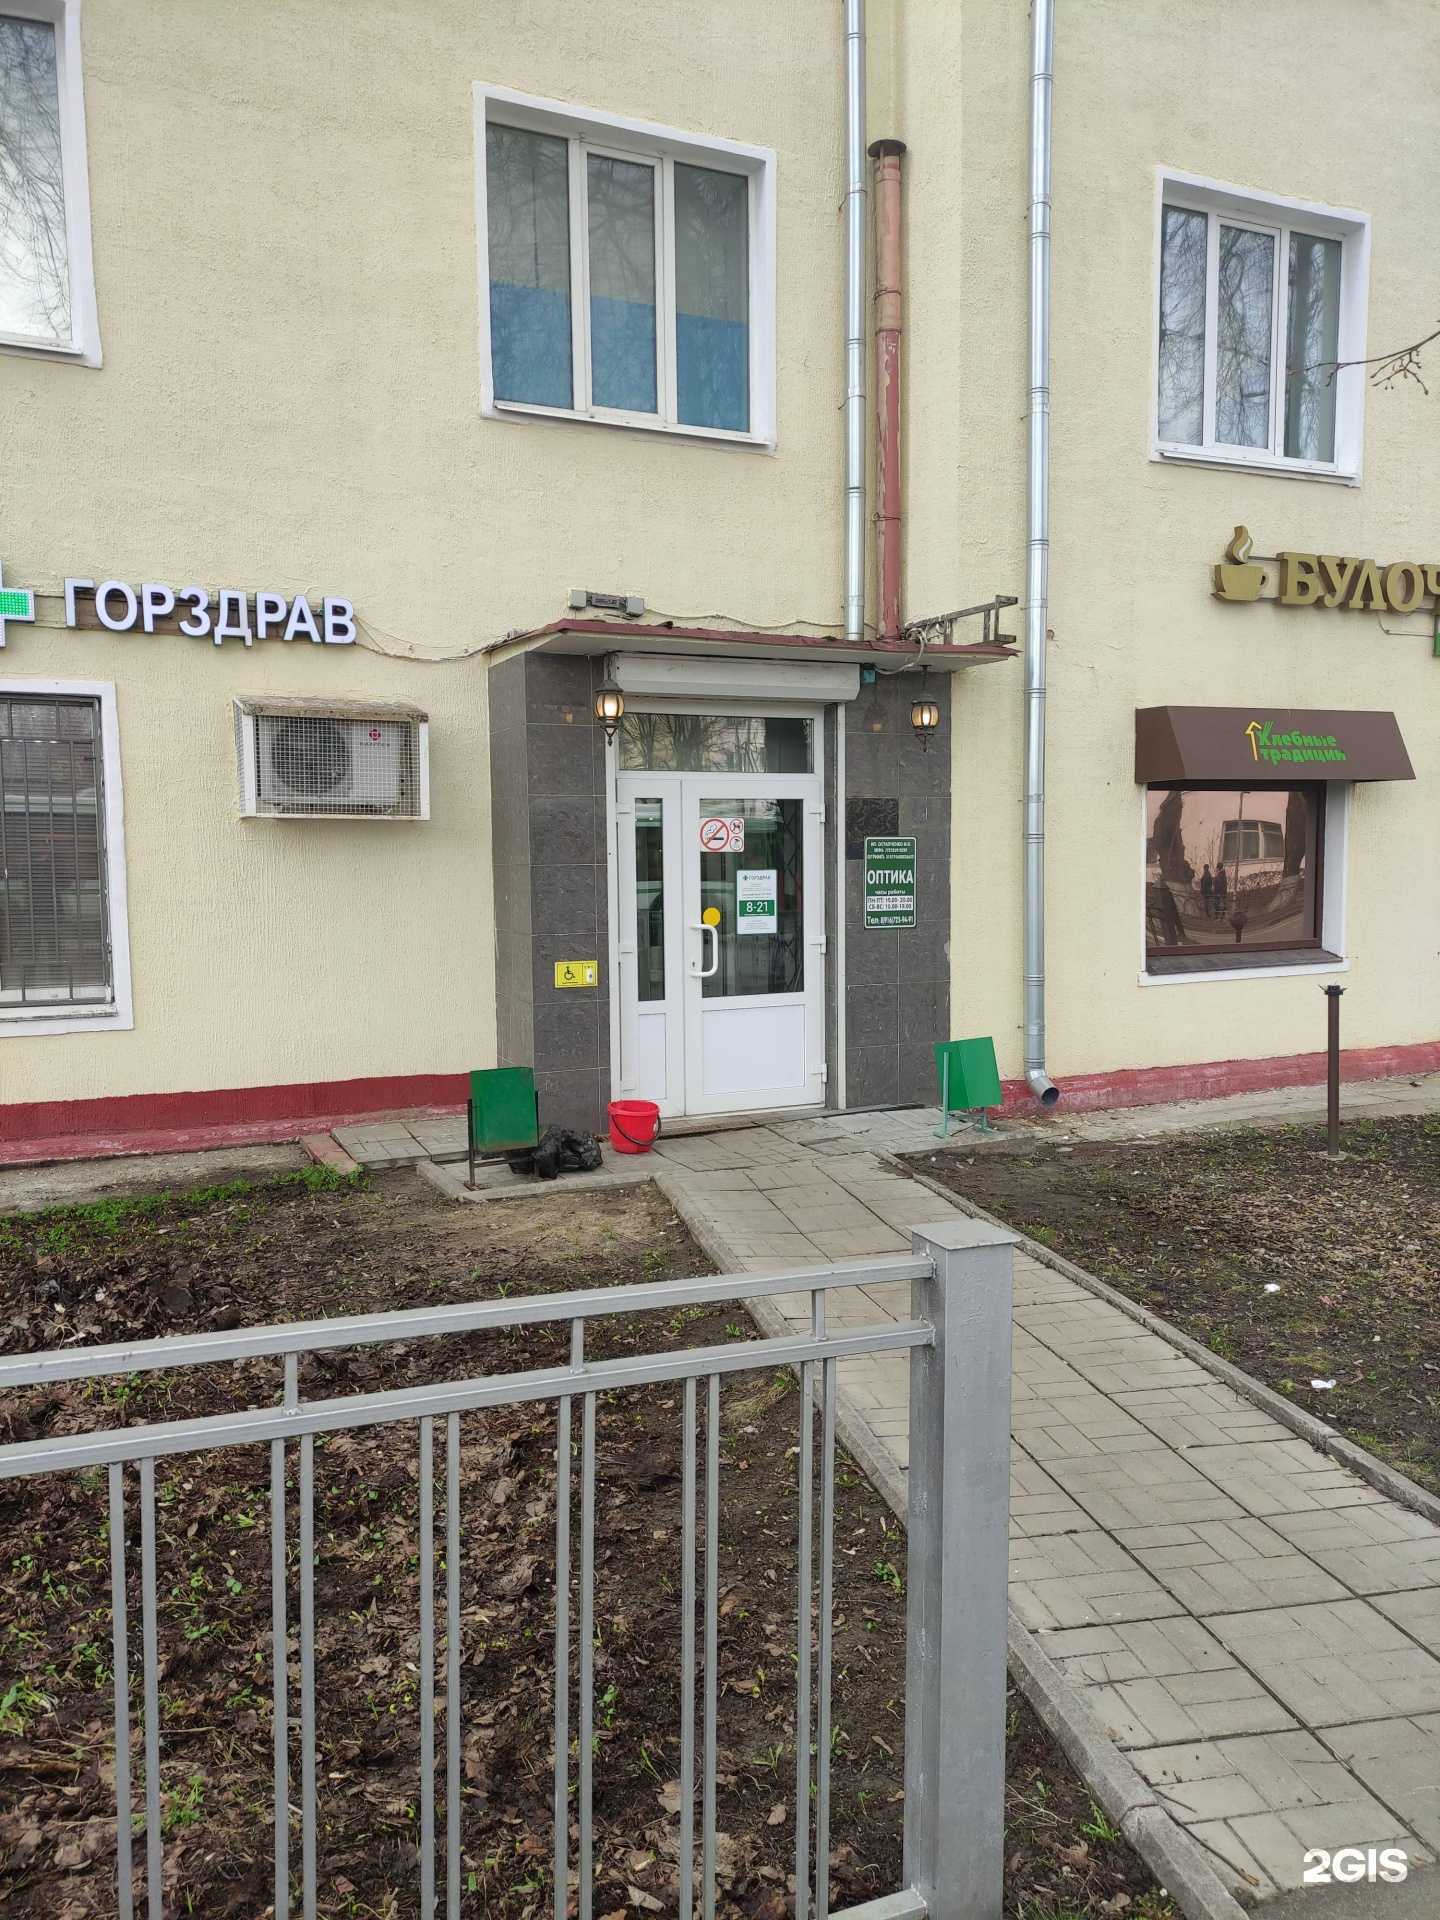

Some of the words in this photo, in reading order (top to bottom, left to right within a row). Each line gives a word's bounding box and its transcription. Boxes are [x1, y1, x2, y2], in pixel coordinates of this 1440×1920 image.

[64, 577, 358, 648] ГОРЗДРАВ
[867, 869, 914, 885] ОПТИКА
[746, 901, 768, 913] 8-21
